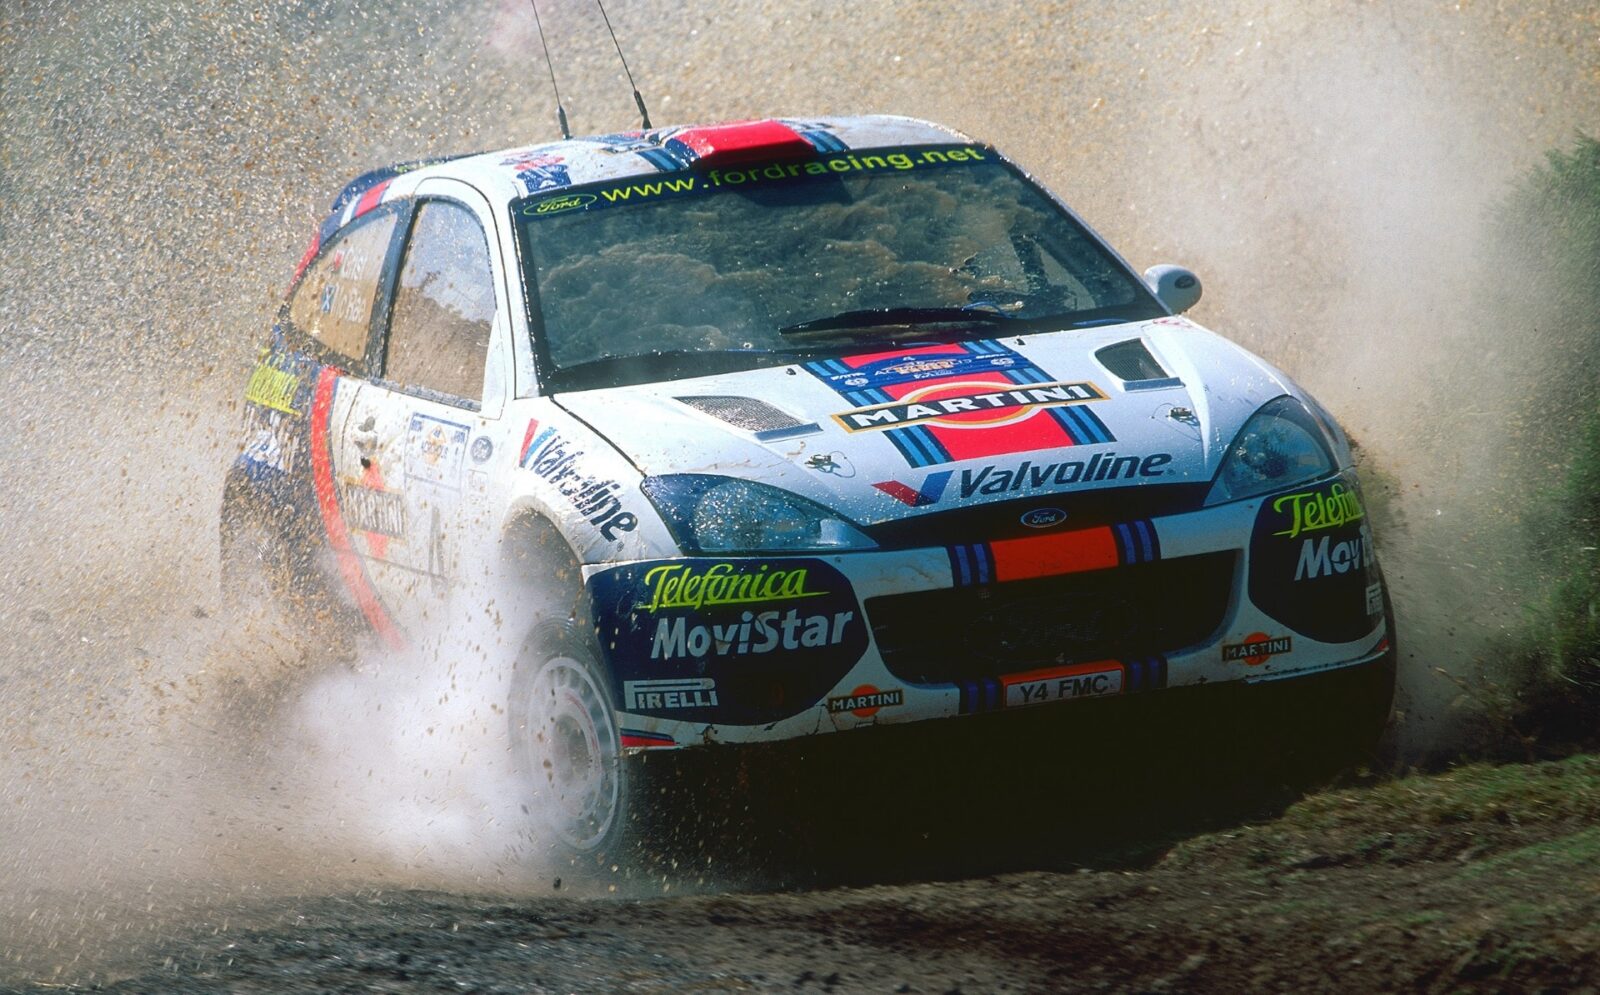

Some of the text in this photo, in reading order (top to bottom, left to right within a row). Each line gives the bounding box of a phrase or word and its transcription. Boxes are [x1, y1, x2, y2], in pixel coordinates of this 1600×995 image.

[601, 147, 985, 201] www.fordracing.net
[537, 196, 581, 213] Ford
[854, 386, 1091, 427] MARTINI
[960, 452, 1173, 499] Valvoline
[651, 609, 853, 660] MoviStar
[1226, 640, 1288, 658] MARTINI
[624, 678, 718, 710] PIRELLI
[832, 692, 899, 711] MARTINI
[1020, 675, 1108, 701] Y4 FMC
